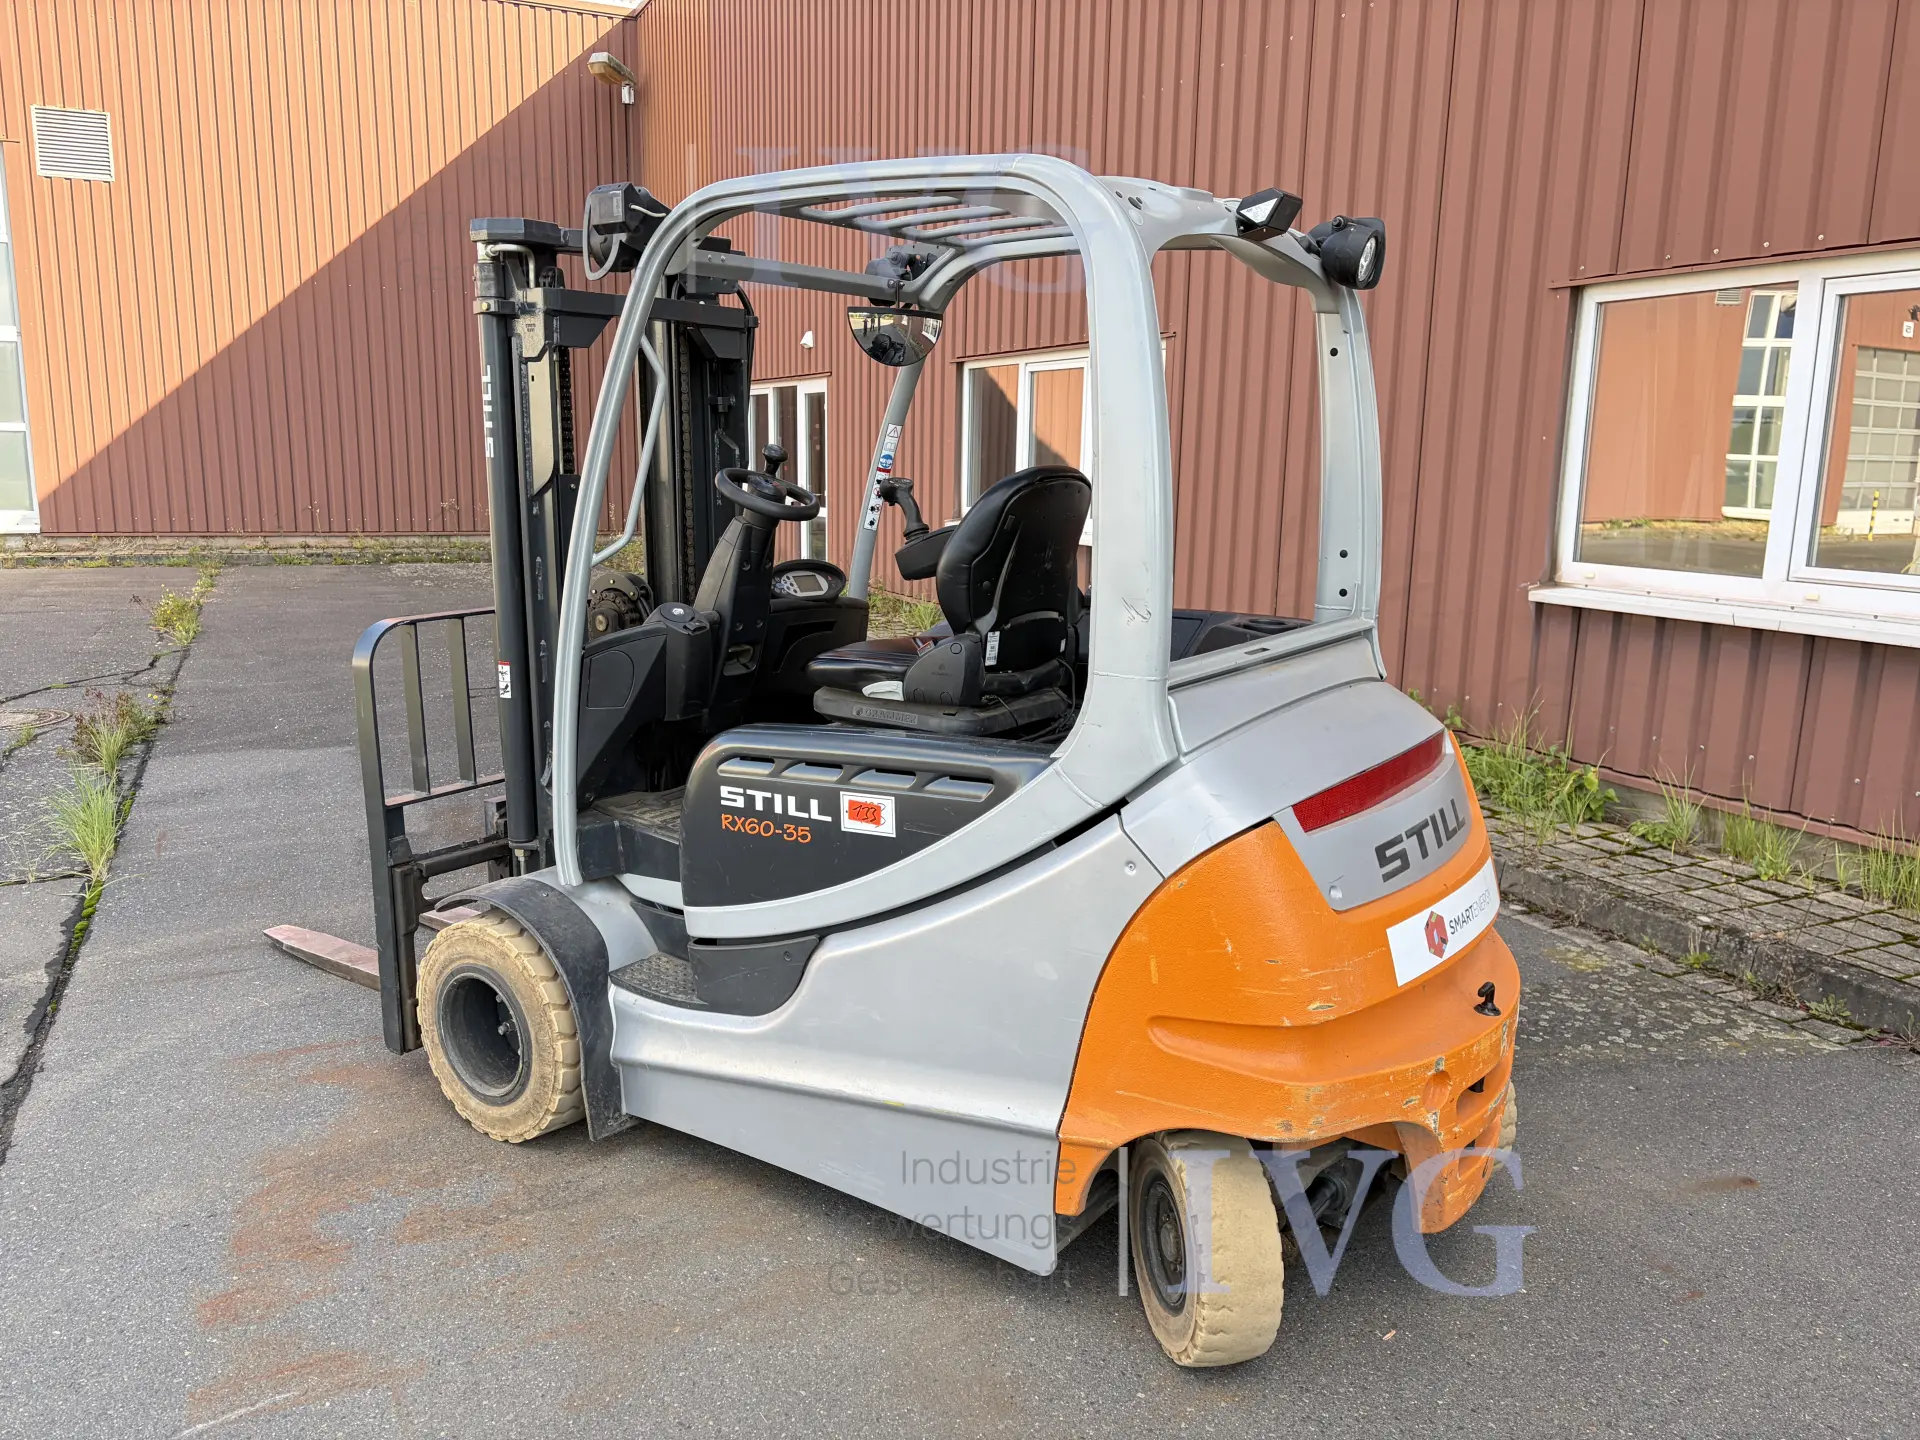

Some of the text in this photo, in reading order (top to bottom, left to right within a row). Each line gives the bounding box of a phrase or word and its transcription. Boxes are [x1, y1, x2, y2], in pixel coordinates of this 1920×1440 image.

[482, 364, 494, 458] STILL
[720, 785, 832, 822] STILL
[721, 813, 812, 844] RX60-35
[1374, 798, 1466, 884] STILL
